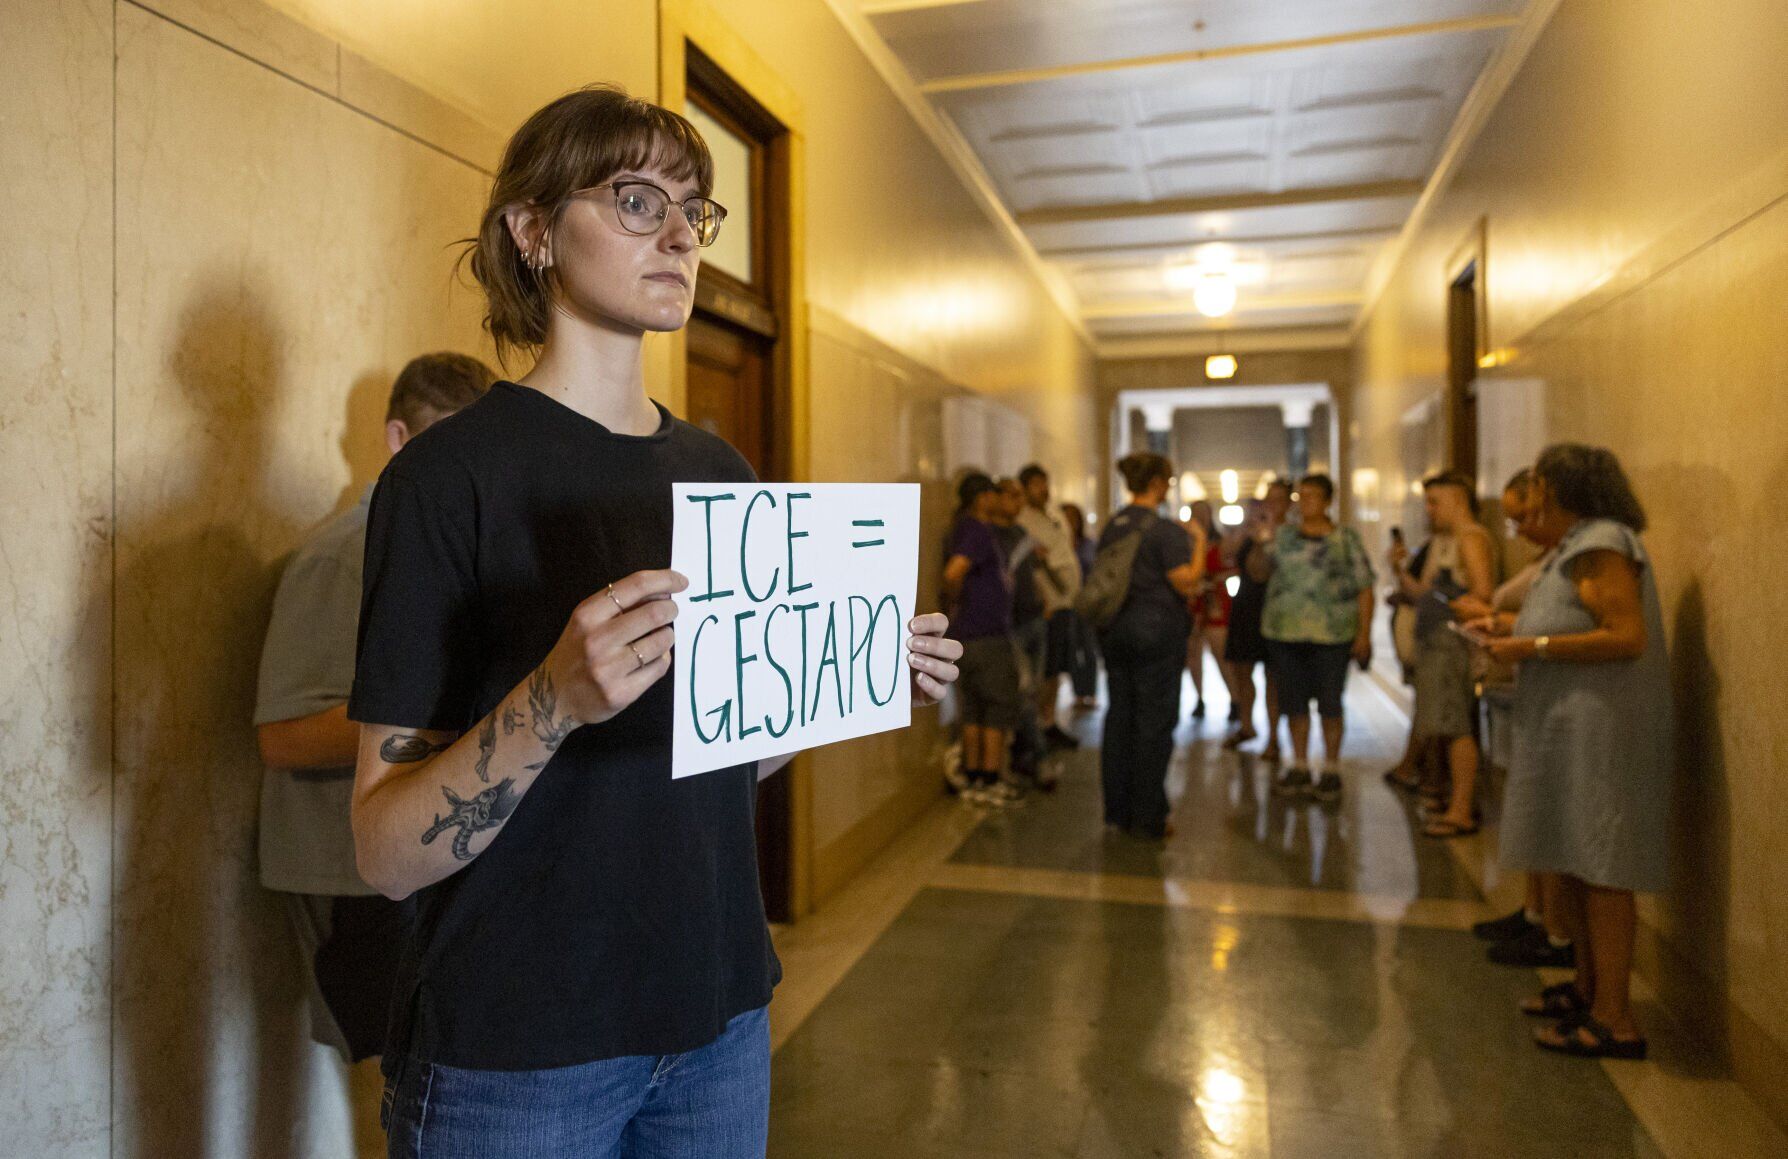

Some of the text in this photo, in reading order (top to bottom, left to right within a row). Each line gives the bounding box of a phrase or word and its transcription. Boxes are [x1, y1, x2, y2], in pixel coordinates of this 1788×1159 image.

[686, 490, 884, 602] ICE =
[690, 594, 900, 744] GESTAPO
